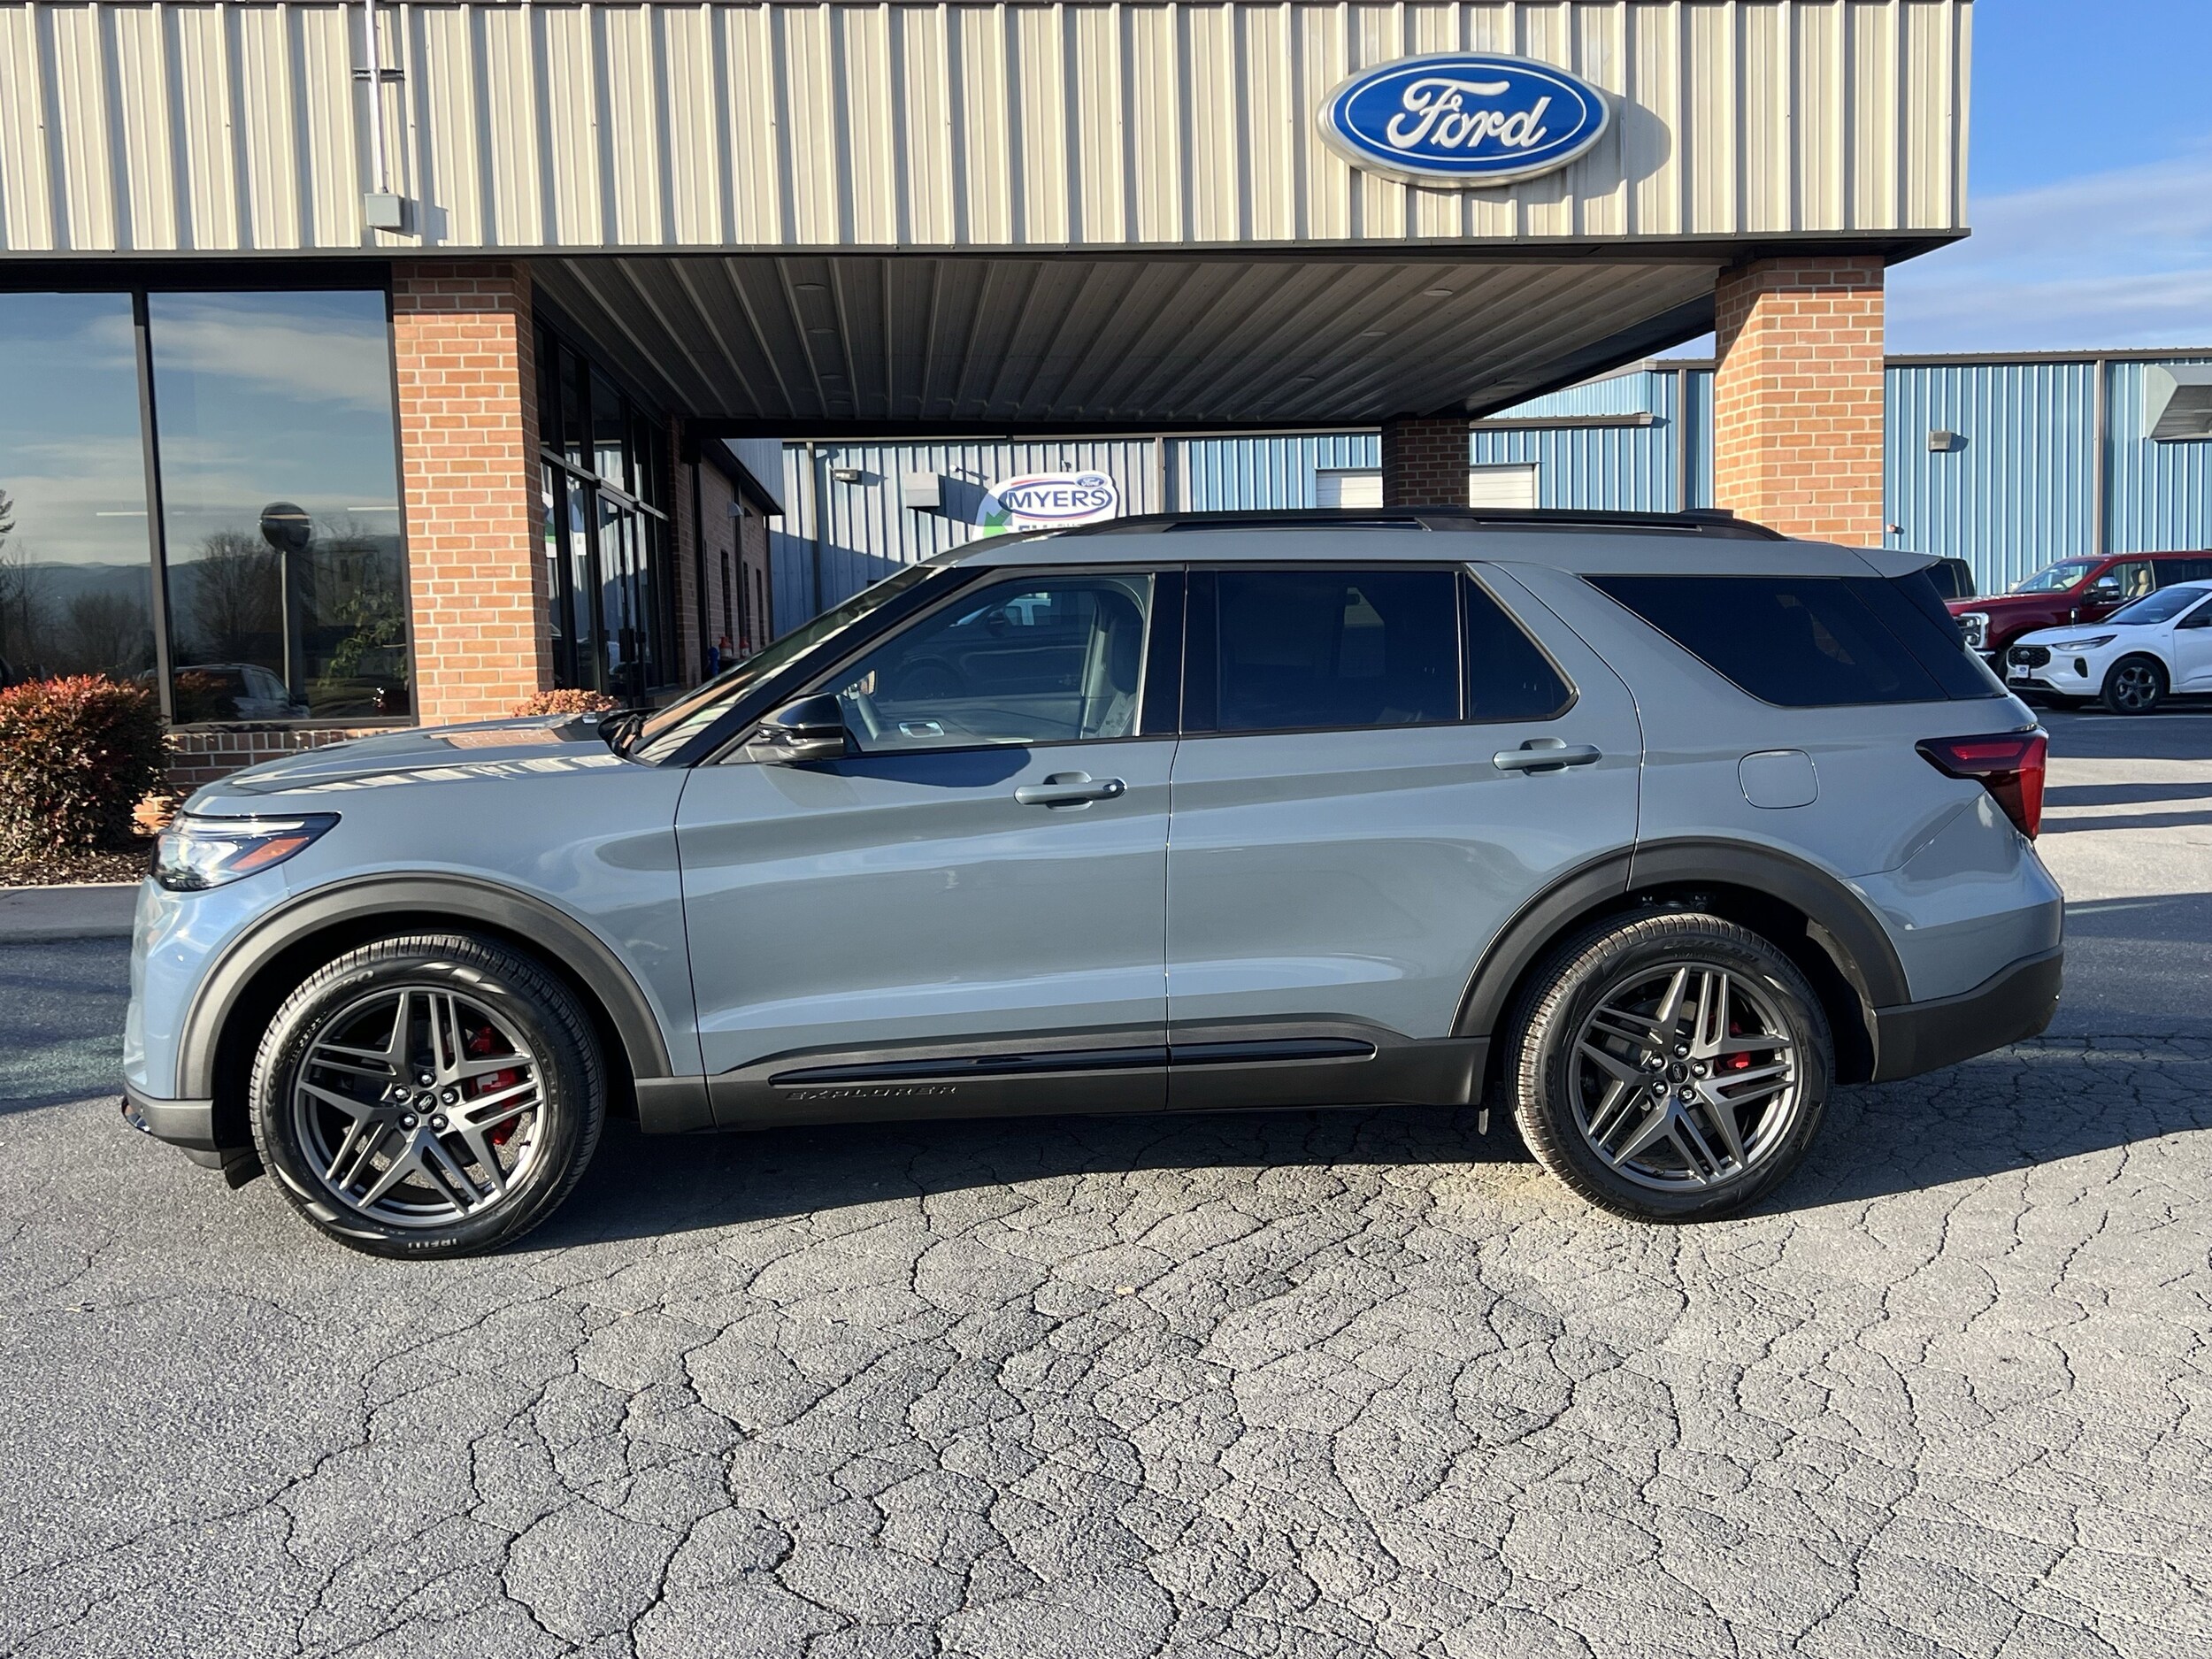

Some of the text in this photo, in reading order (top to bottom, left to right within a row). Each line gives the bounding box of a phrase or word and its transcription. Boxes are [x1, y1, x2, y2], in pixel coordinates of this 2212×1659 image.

[1386, 77, 1553, 150] Ford
[1007, 489, 1106, 509] MYERS
[786, 1086, 956, 1101] EXPLORER
